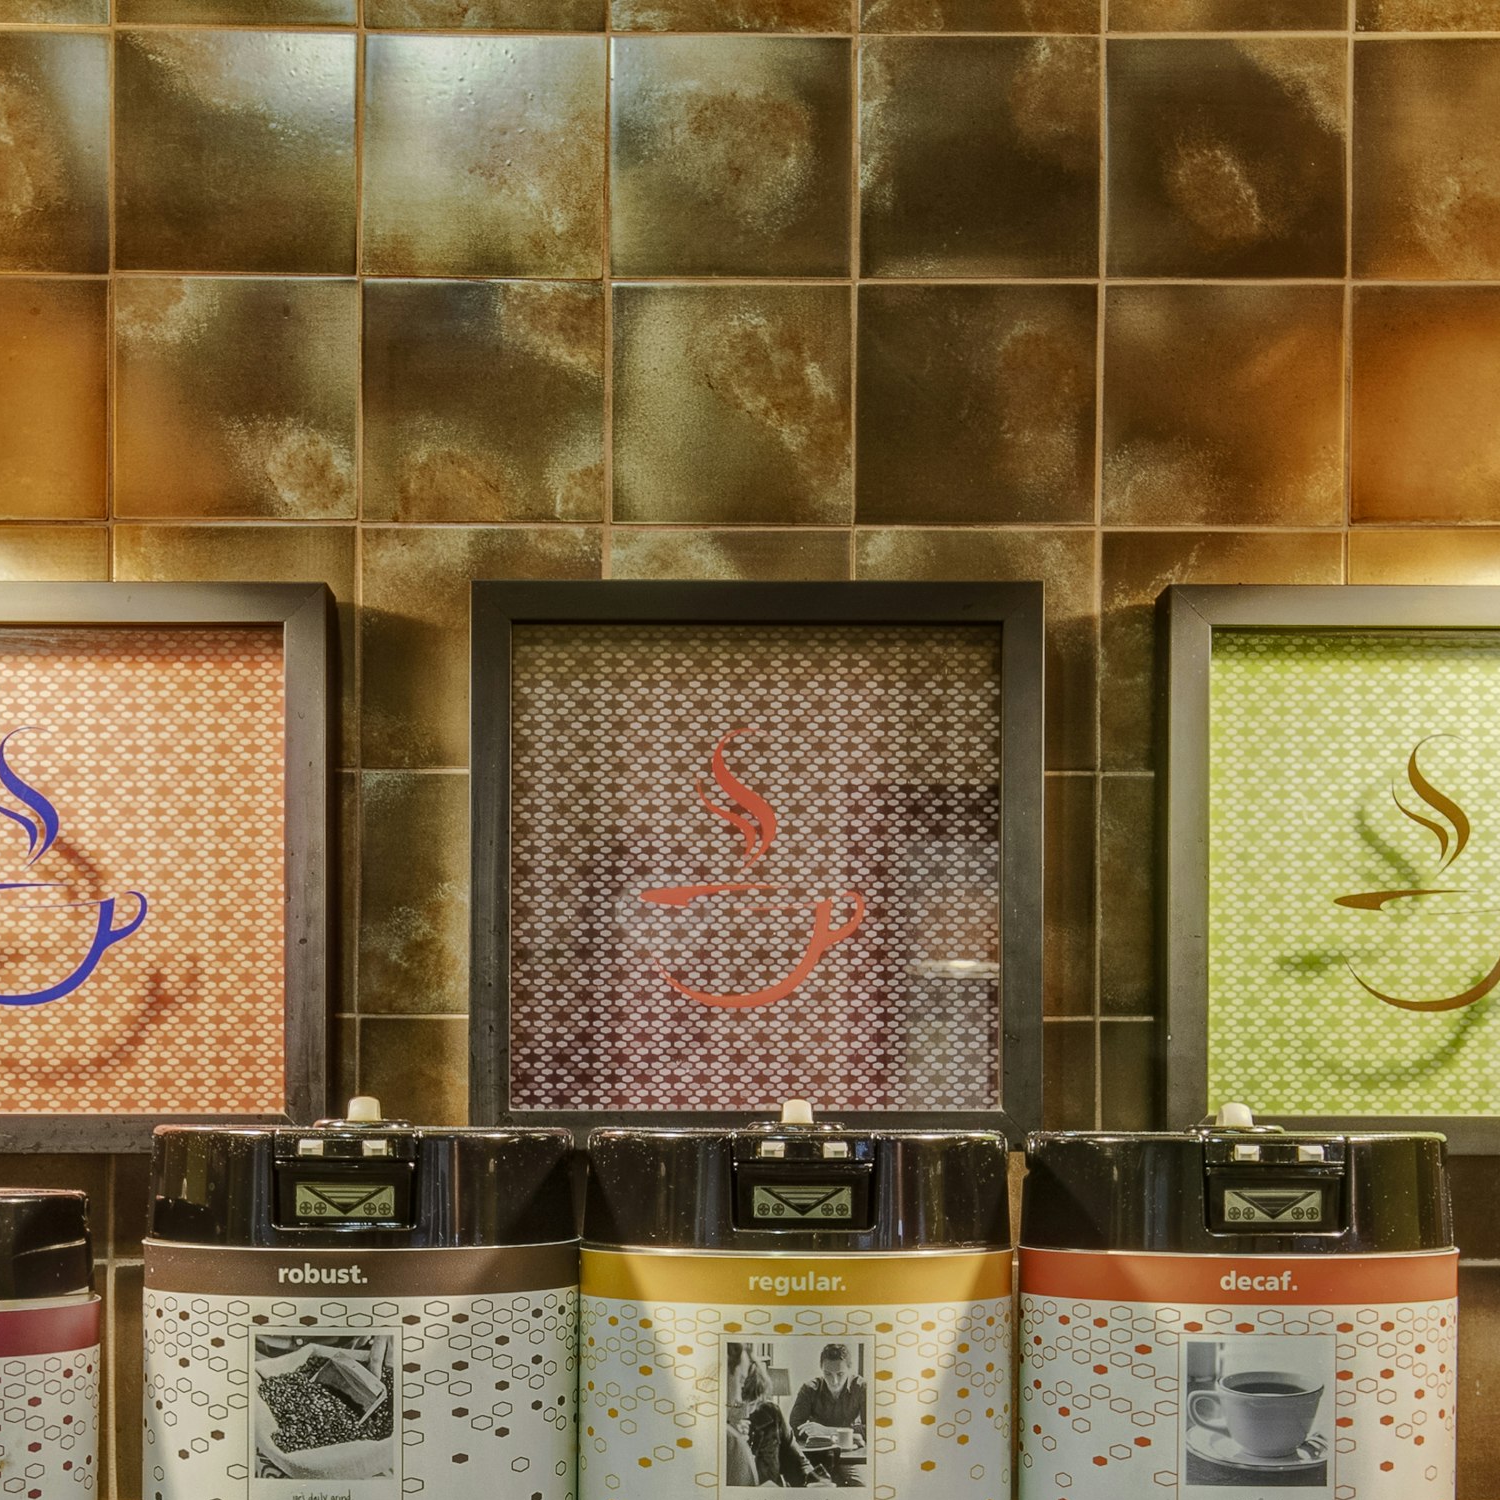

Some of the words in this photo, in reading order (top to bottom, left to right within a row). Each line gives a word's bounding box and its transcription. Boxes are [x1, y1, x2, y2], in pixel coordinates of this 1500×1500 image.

[278, 1262, 368, 1284] robust.
[748, 1270, 846, 1296] regular.
[1220, 1270, 1298, 1291] decaf.
